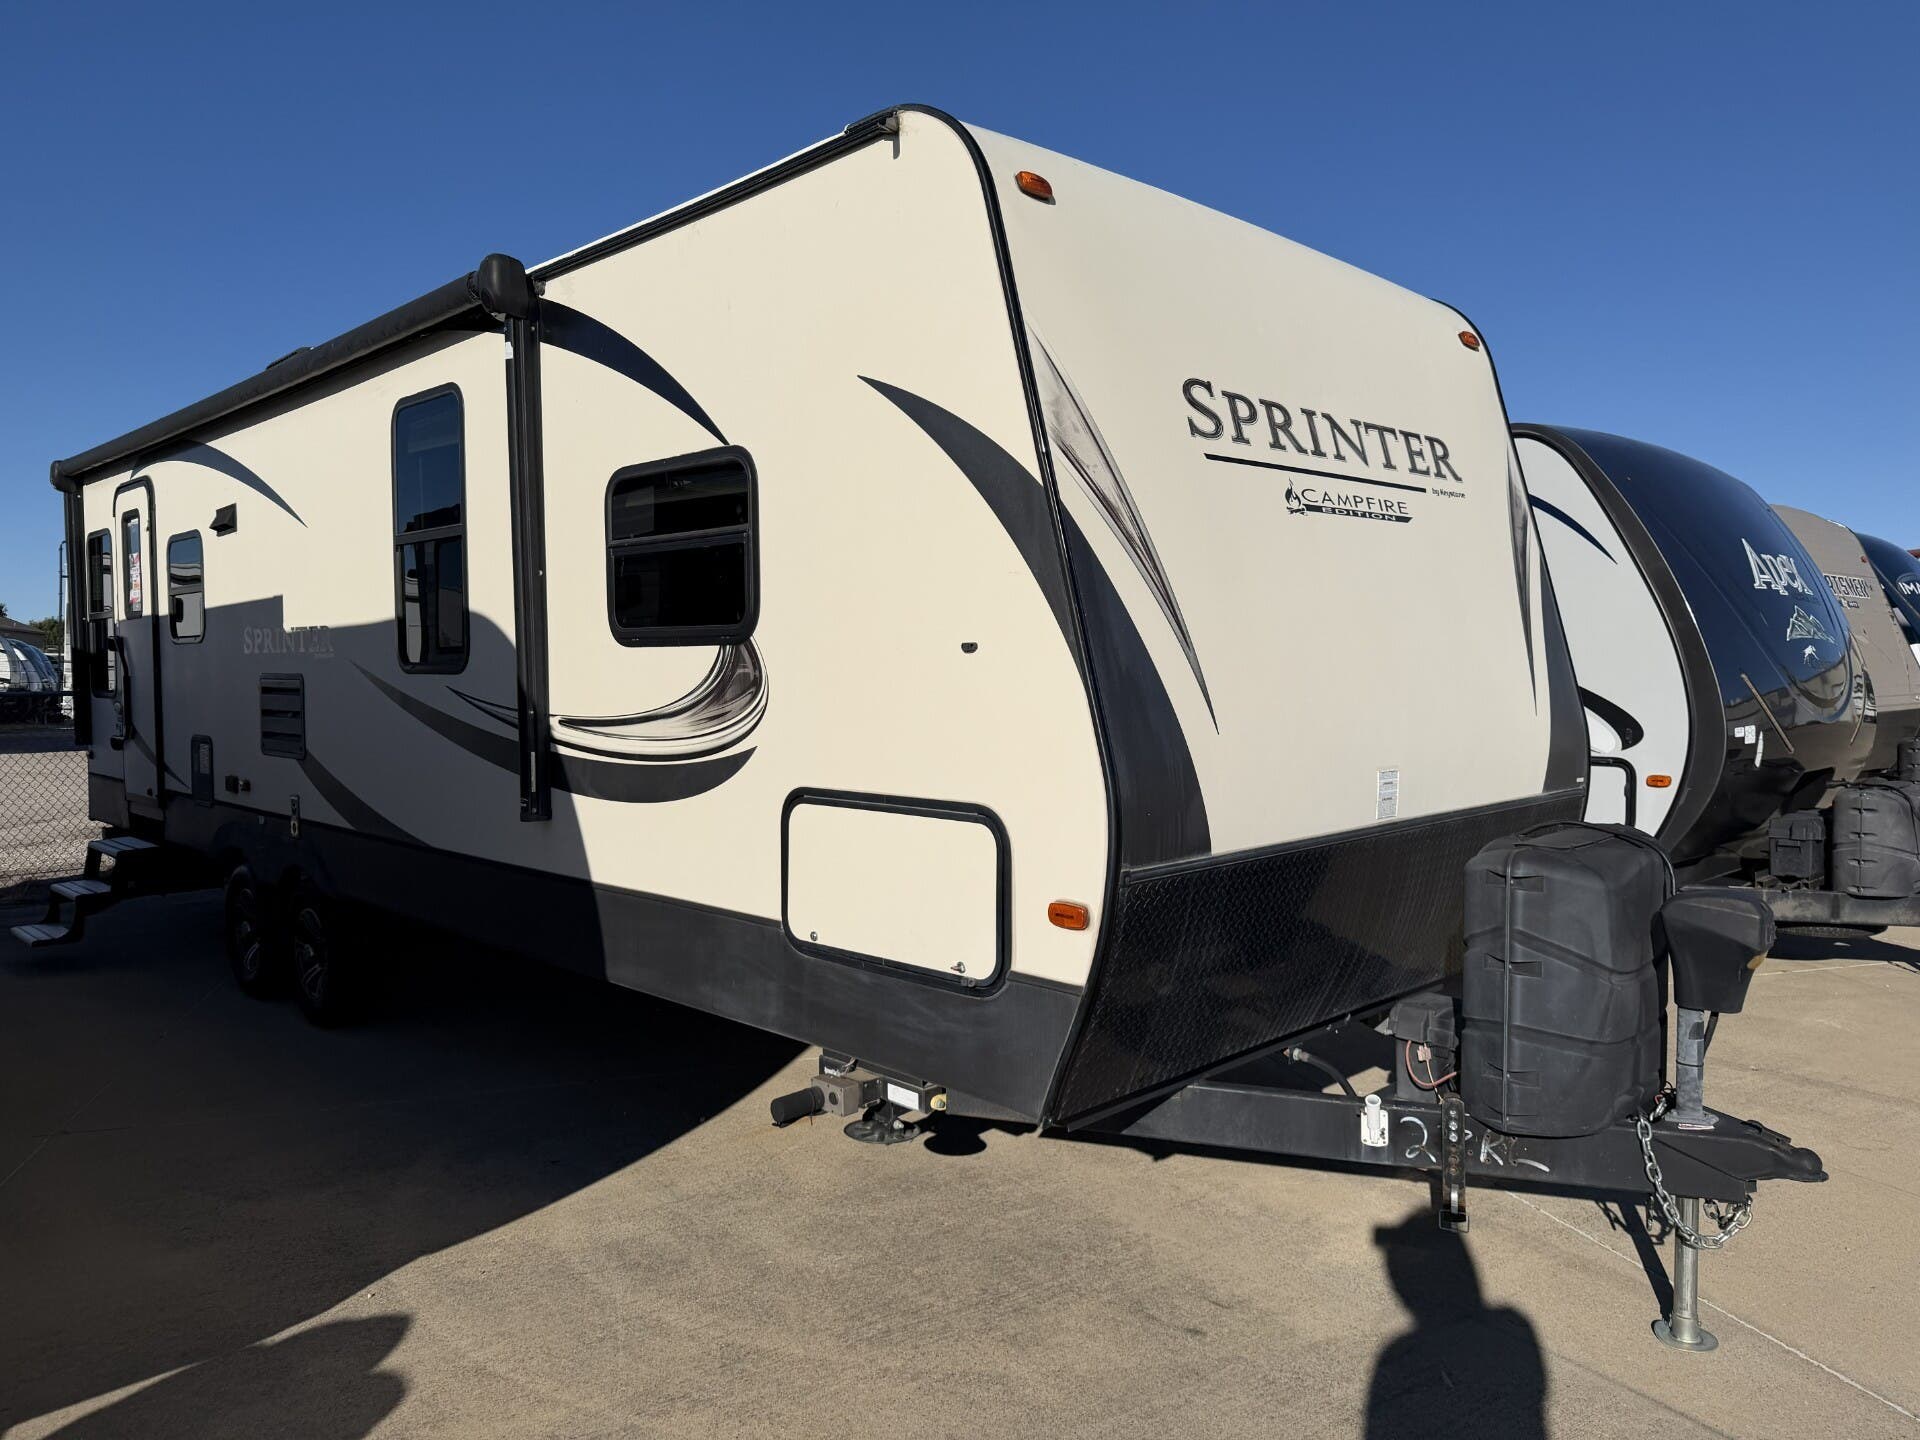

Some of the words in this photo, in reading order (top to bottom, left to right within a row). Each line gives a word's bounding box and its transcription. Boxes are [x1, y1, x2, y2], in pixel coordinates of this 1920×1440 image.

[1182, 377, 1463, 483] SPRINTER
[1301, 488, 1409, 515] CAMPFIRE
[1321, 506, 1397, 521] EDITION
[243, 625, 334, 655] SPRINTER
